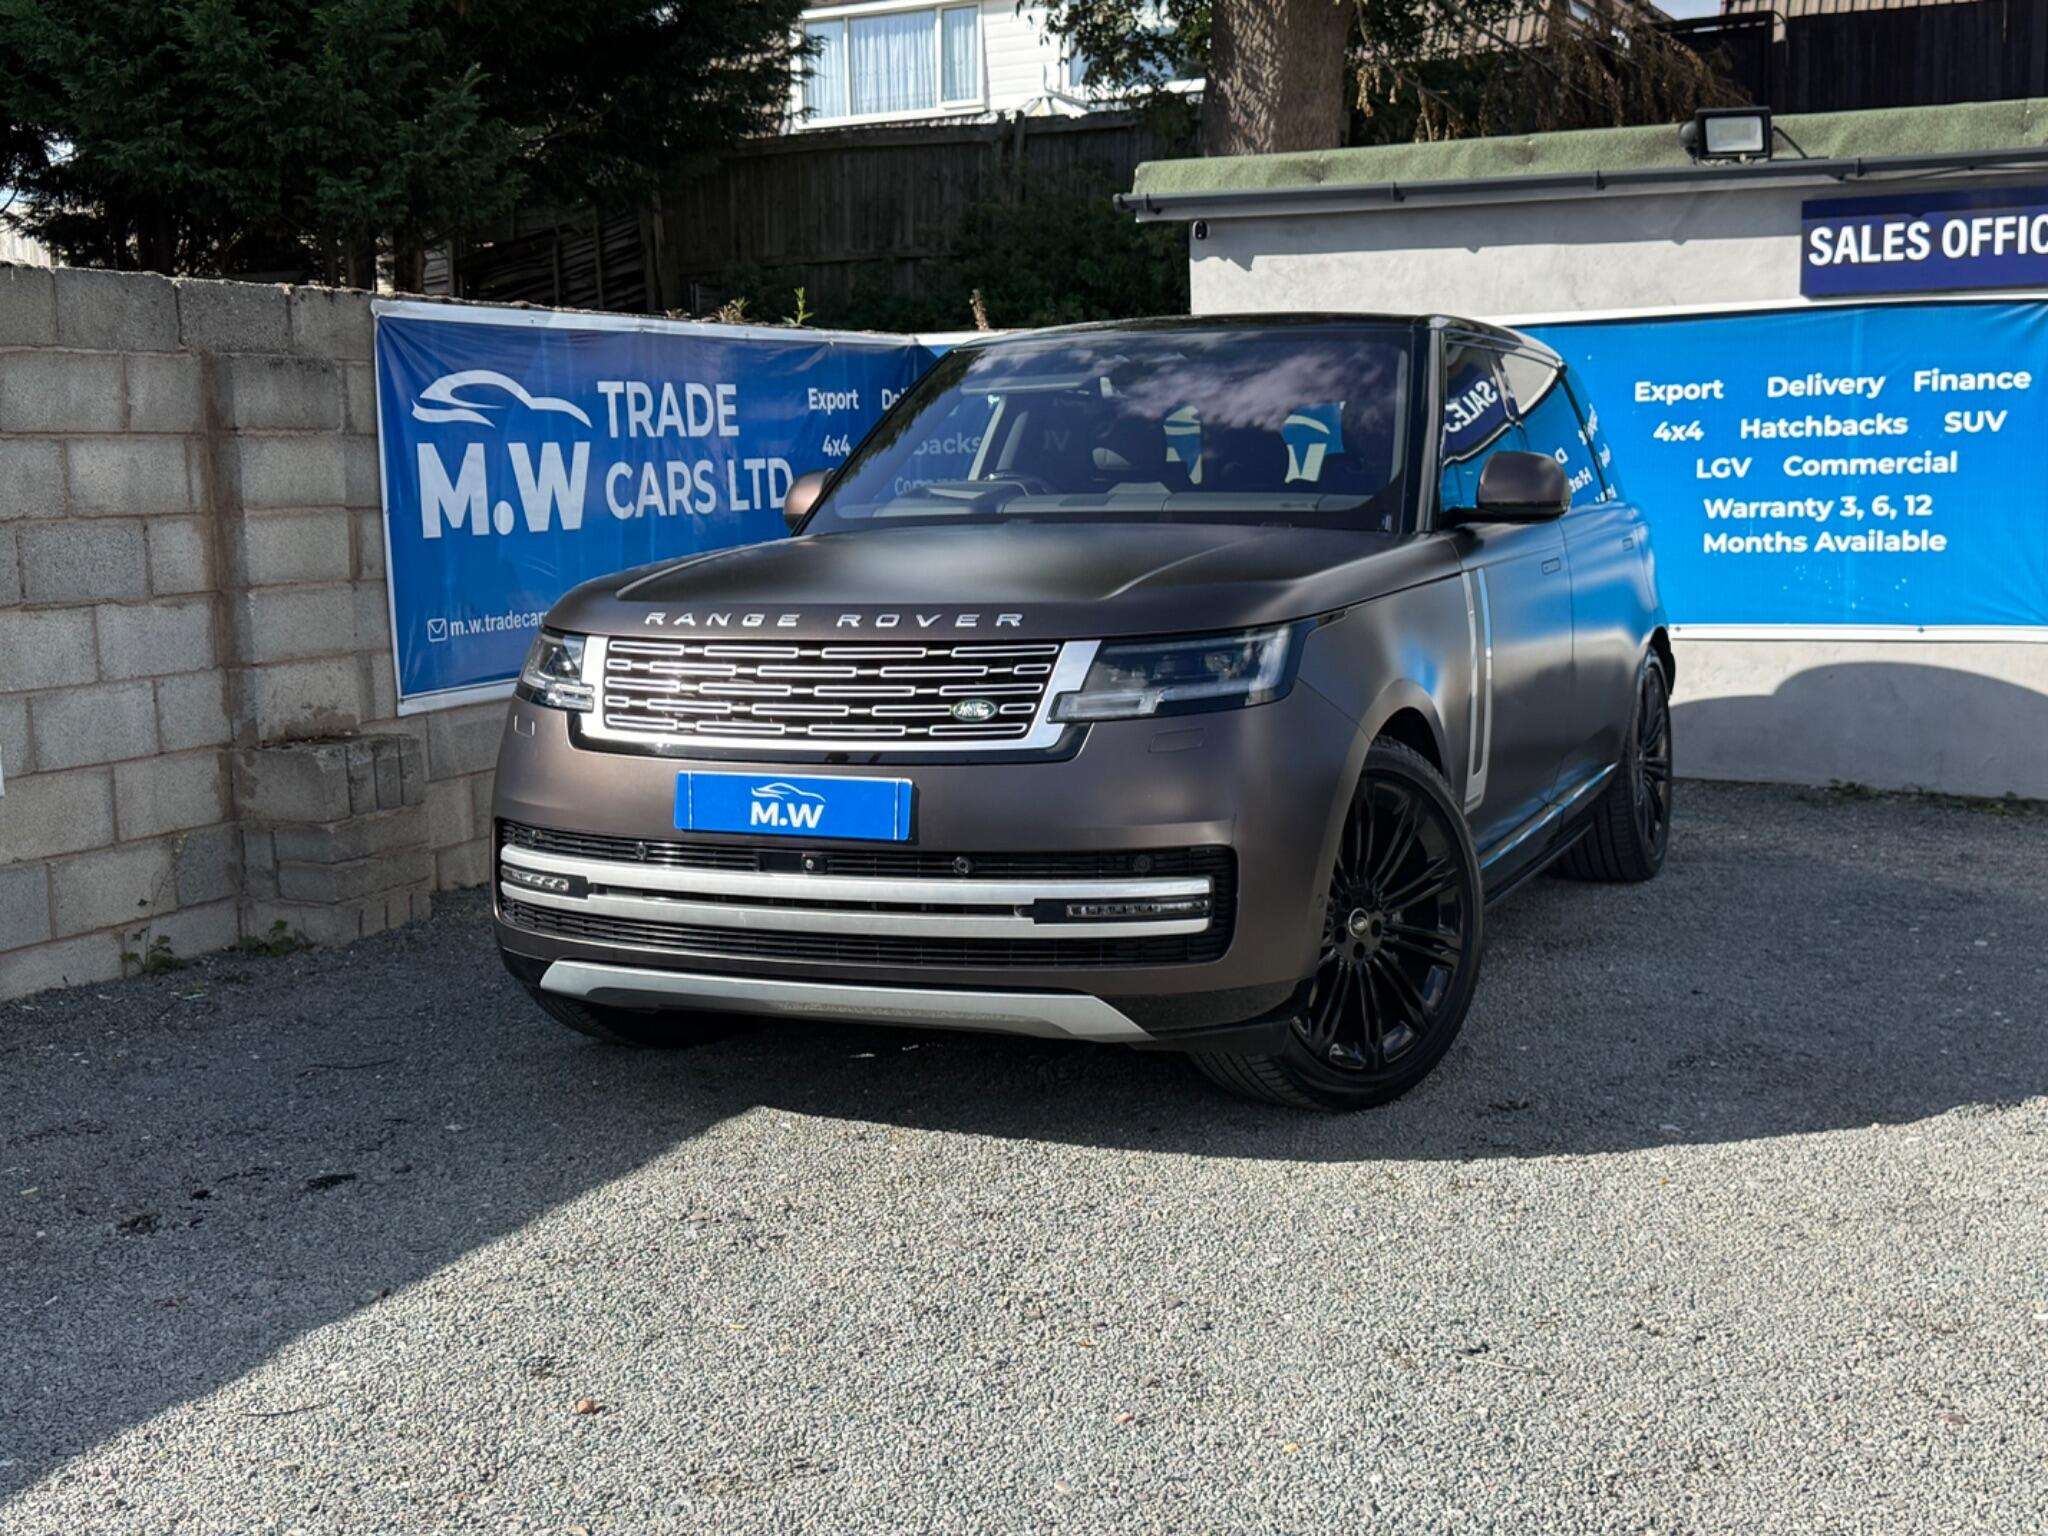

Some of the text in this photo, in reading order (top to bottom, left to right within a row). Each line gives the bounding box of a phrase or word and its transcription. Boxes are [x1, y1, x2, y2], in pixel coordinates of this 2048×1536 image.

[1808, 220, 1931, 267] SALES
[1634, 367, 2032, 405] Export Delivery Finance
[597, 380, 740, 438] TRADE
[807, 387, 860, 416] Export
[1653, 410, 2008, 442] 4x4 Hatchbacks SUV
[822, 433, 852, 457] 4x4
[1696, 449, 1958, 479] LGV Commercial
[417, 441, 591, 539] M.W
[605, 457, 793, 520] CARS LTD
[1703, 494, 1933, 522] Warranty 3, 6, 12
[1703, 528, 1948, 554] Months Available
[449, 610, 548, 637] m.w.tradecar
[644, 611, 1023, 629] RANGE ROVER
[750, 801, 825, 829] M.W
